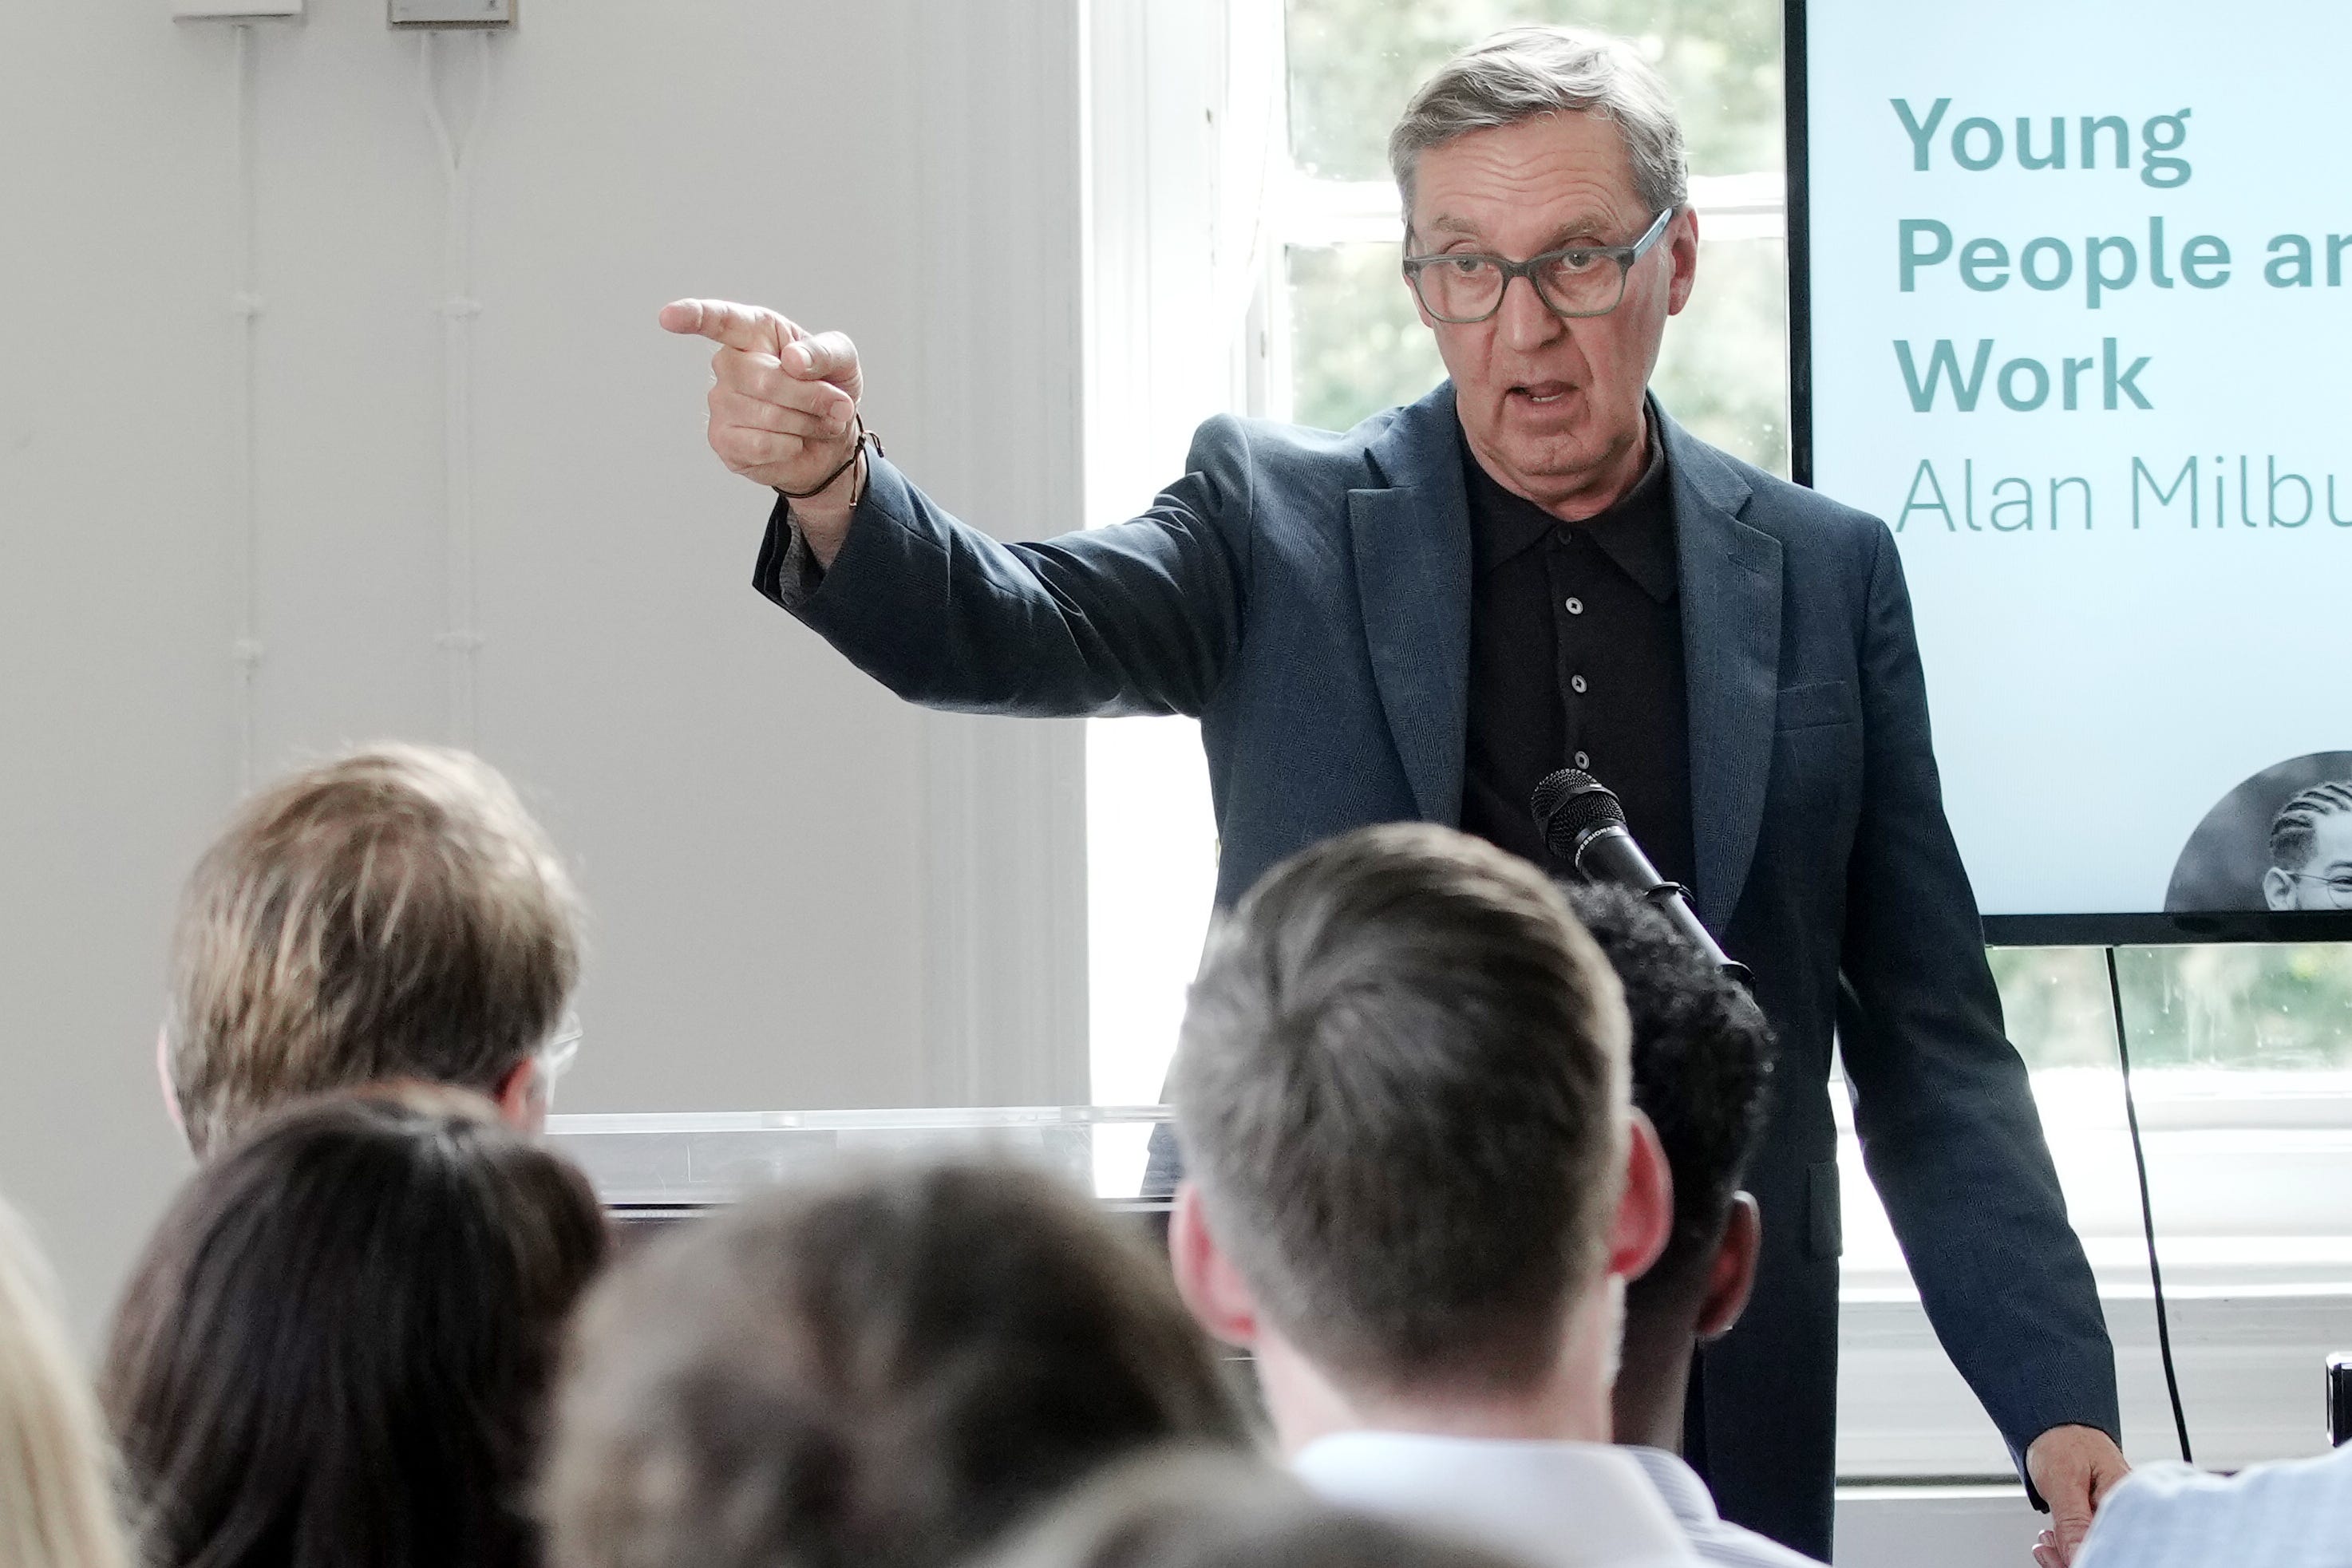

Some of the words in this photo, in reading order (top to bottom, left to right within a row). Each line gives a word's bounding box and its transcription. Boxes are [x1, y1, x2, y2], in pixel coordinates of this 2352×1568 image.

[1890, 97, 2193, 188] Young
[1899, 215, 2232, 310] People
[1893, 336, 2154, 413] Work
[1895, 458, 2093, 532] Alan
